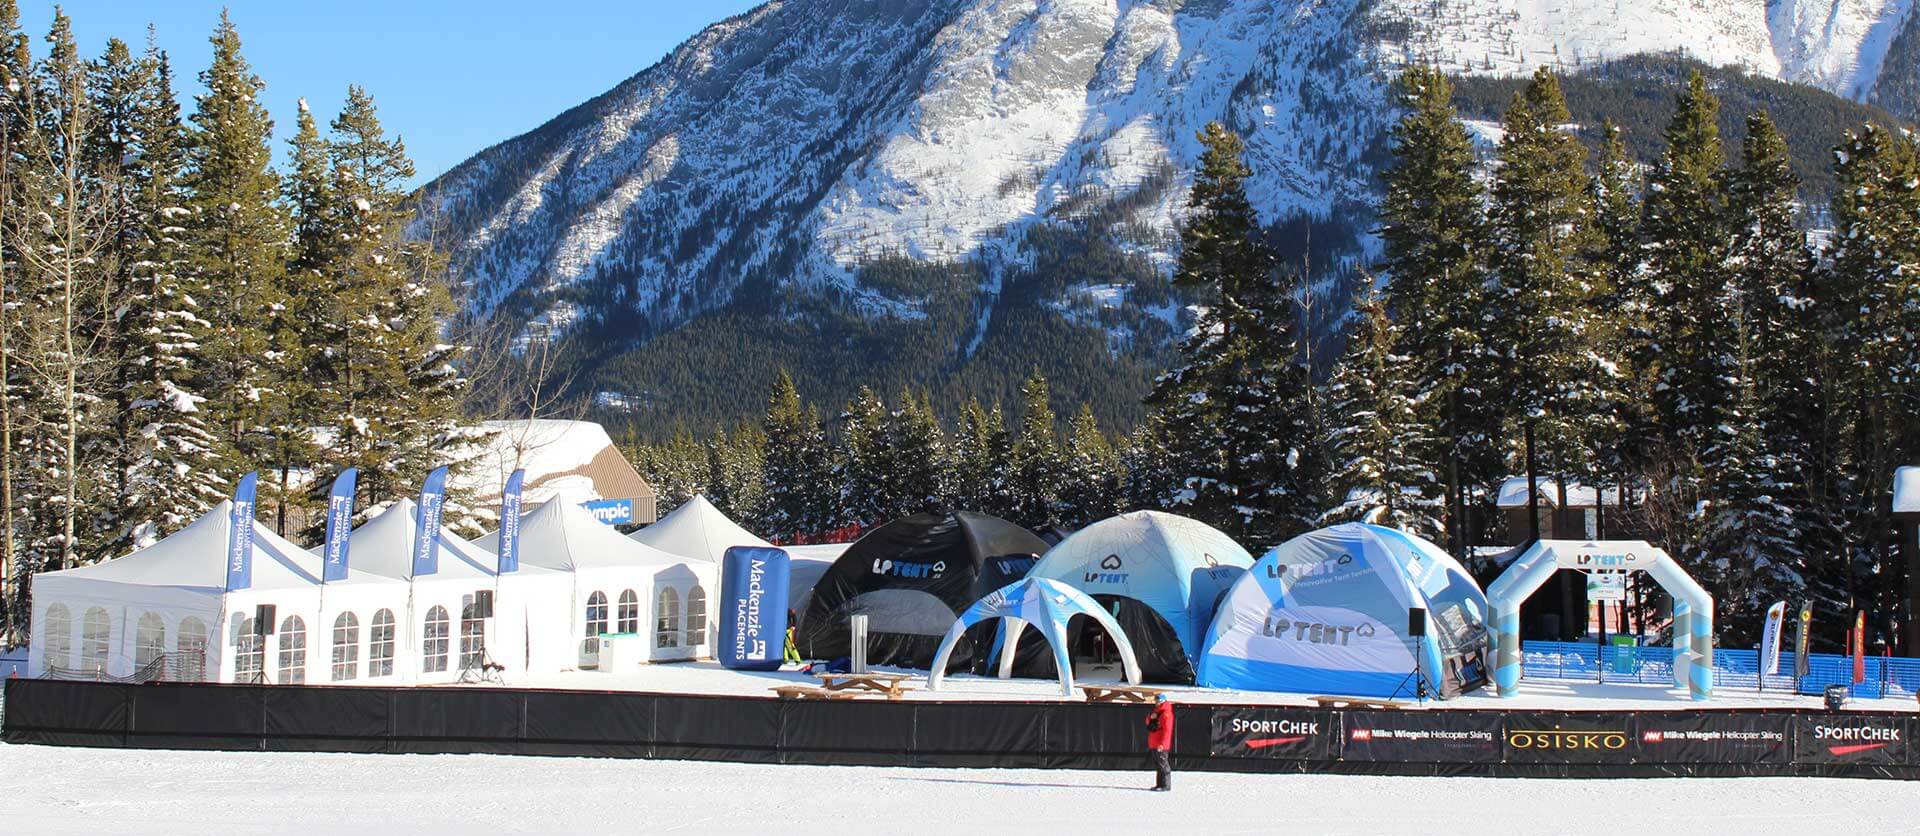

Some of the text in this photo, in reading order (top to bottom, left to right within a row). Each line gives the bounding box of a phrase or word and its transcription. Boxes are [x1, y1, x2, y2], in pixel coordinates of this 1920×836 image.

[232, 515, 246, 572] Mackenzie
[329, 511, 344, 564] Mackenzie
[419, 507, 434, 559] Mackenzie
[503, 508, 515, 558] Mackenzie
[747, 559, 766, 637] Mackenzie
[736, 599, 747, 660] PLACEMENTS
[1371, 729, 1392, 738] Mike
[1394, 730, 1429, 740] Wiegele
[1430, 731, 1468, 741] Helicopter
[1510, 733, 1626, 749] OSISKO
[1663, 731, 1685, 739] Mike
[1686, 732, 1721, 741] Wiegele
[1722, 732, 1760, 741] Helicopter
